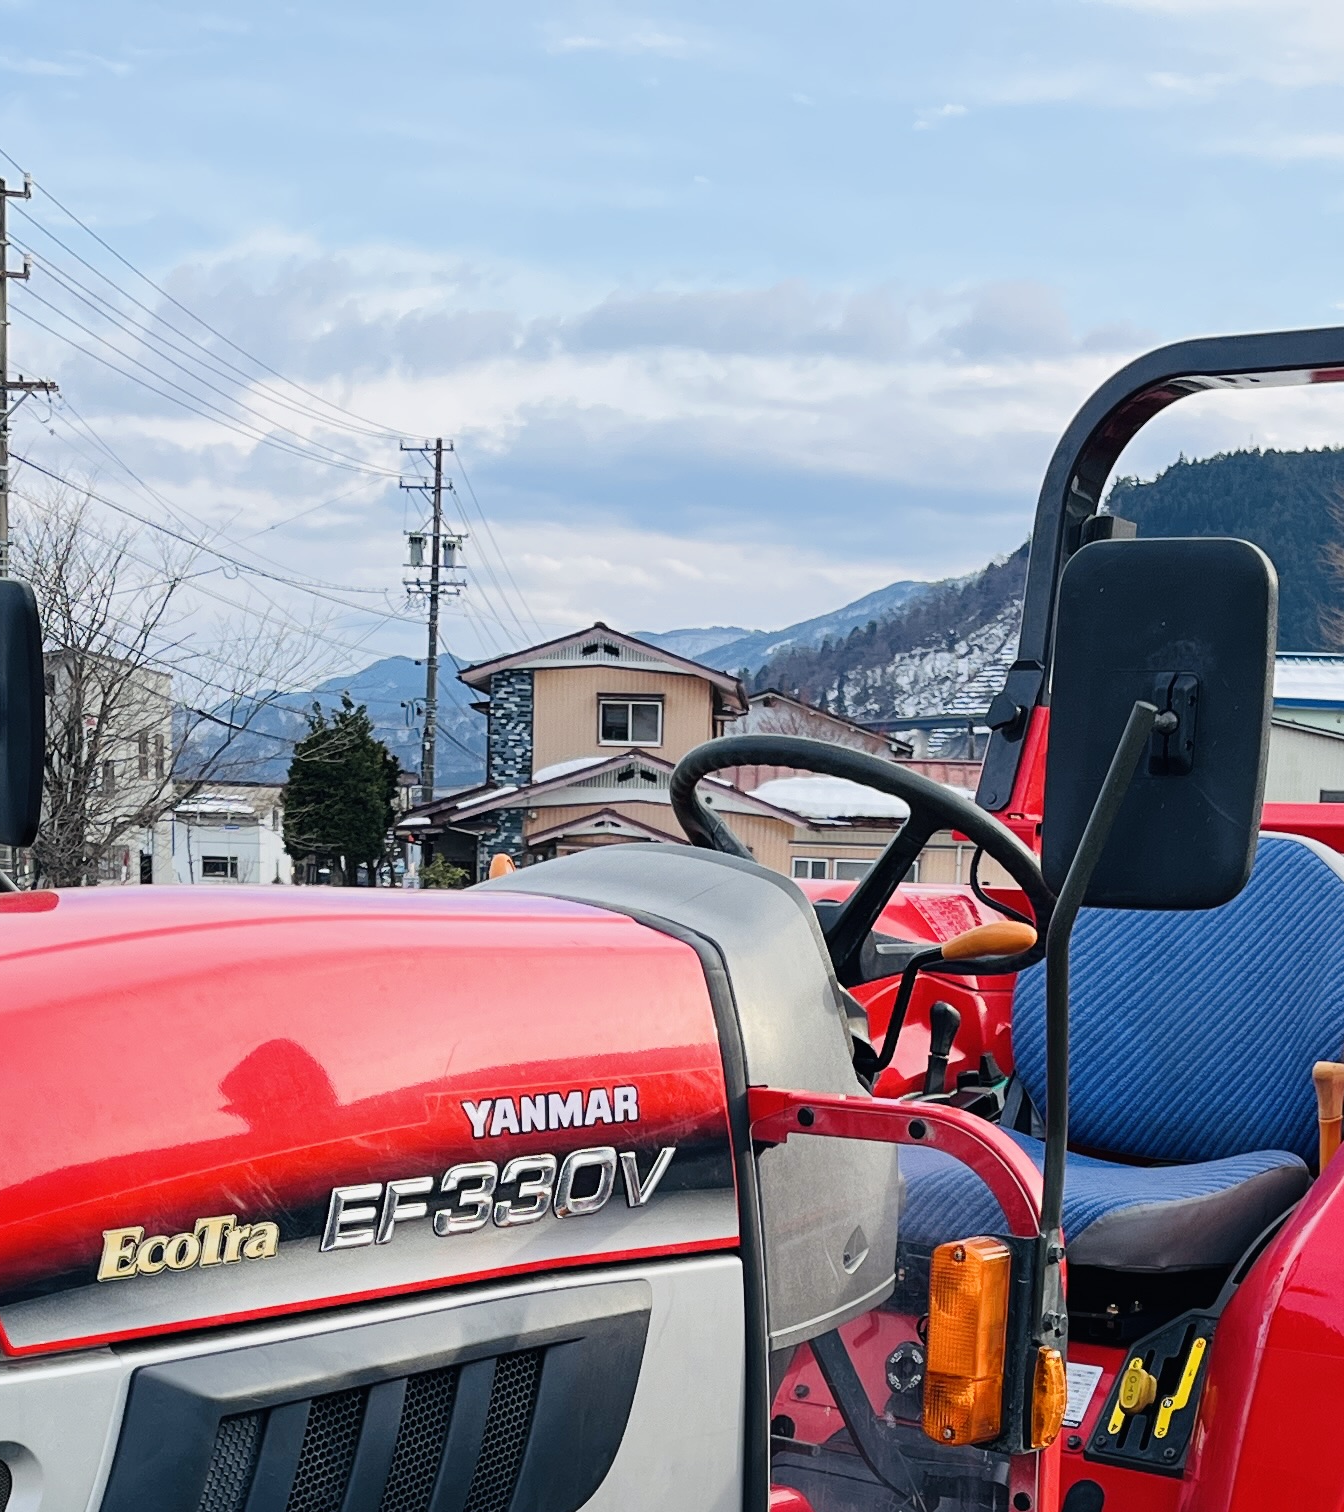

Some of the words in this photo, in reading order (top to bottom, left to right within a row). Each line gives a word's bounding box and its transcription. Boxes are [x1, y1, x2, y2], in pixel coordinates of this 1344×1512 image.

[461, 1085, 639, 1139] YANMAR
[320, 1146, 676, 1253] EF330V
[97, 1214, 279, 1283] EcoTra
